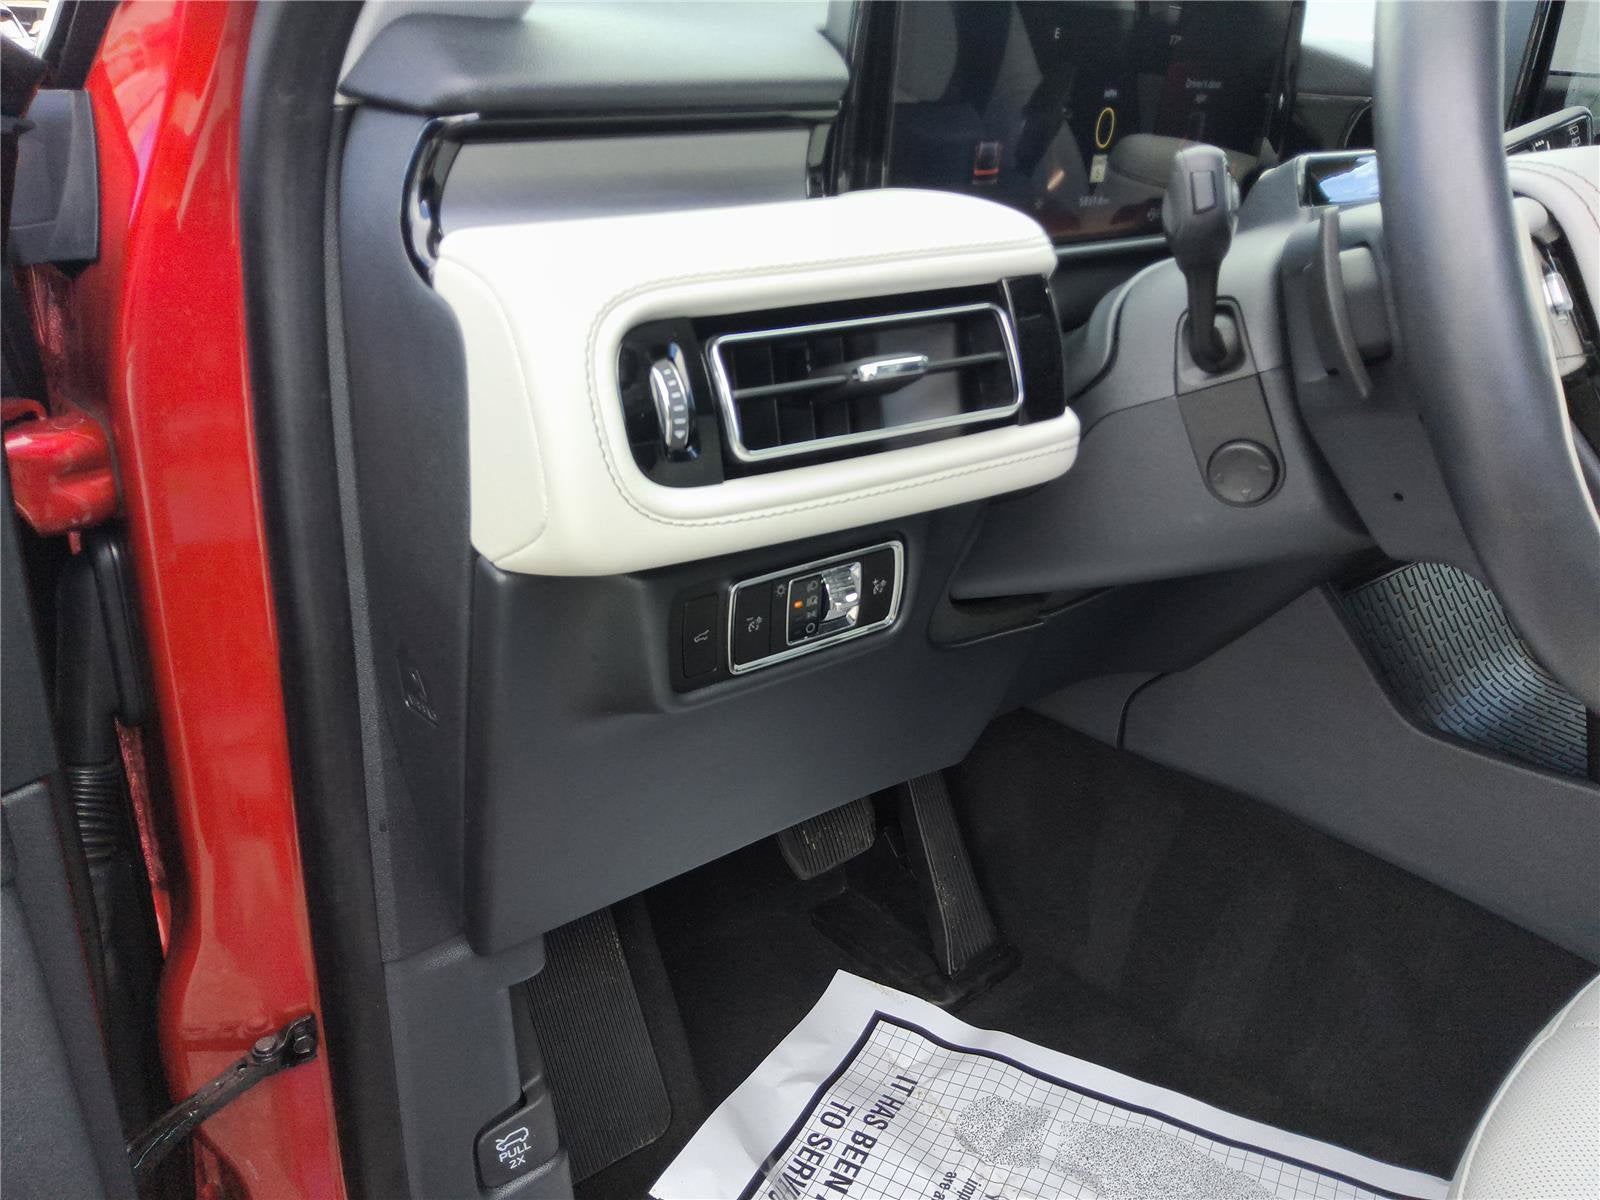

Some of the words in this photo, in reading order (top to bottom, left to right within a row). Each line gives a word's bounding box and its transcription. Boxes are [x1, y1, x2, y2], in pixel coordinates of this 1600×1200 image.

[1095, 107, 1116, 149] 0
[890, 1074, 919, 1098] IT
[819, 1100, 856, 1130] TO
[862, 1093, 905, 1131] HAS
[499, 1142, 532, 1162] PULL
[509, 1154, 526, 1169] 2X
[824, 1130, 878, 1195] BEEN
[939, 1171, 957, 1190] are
